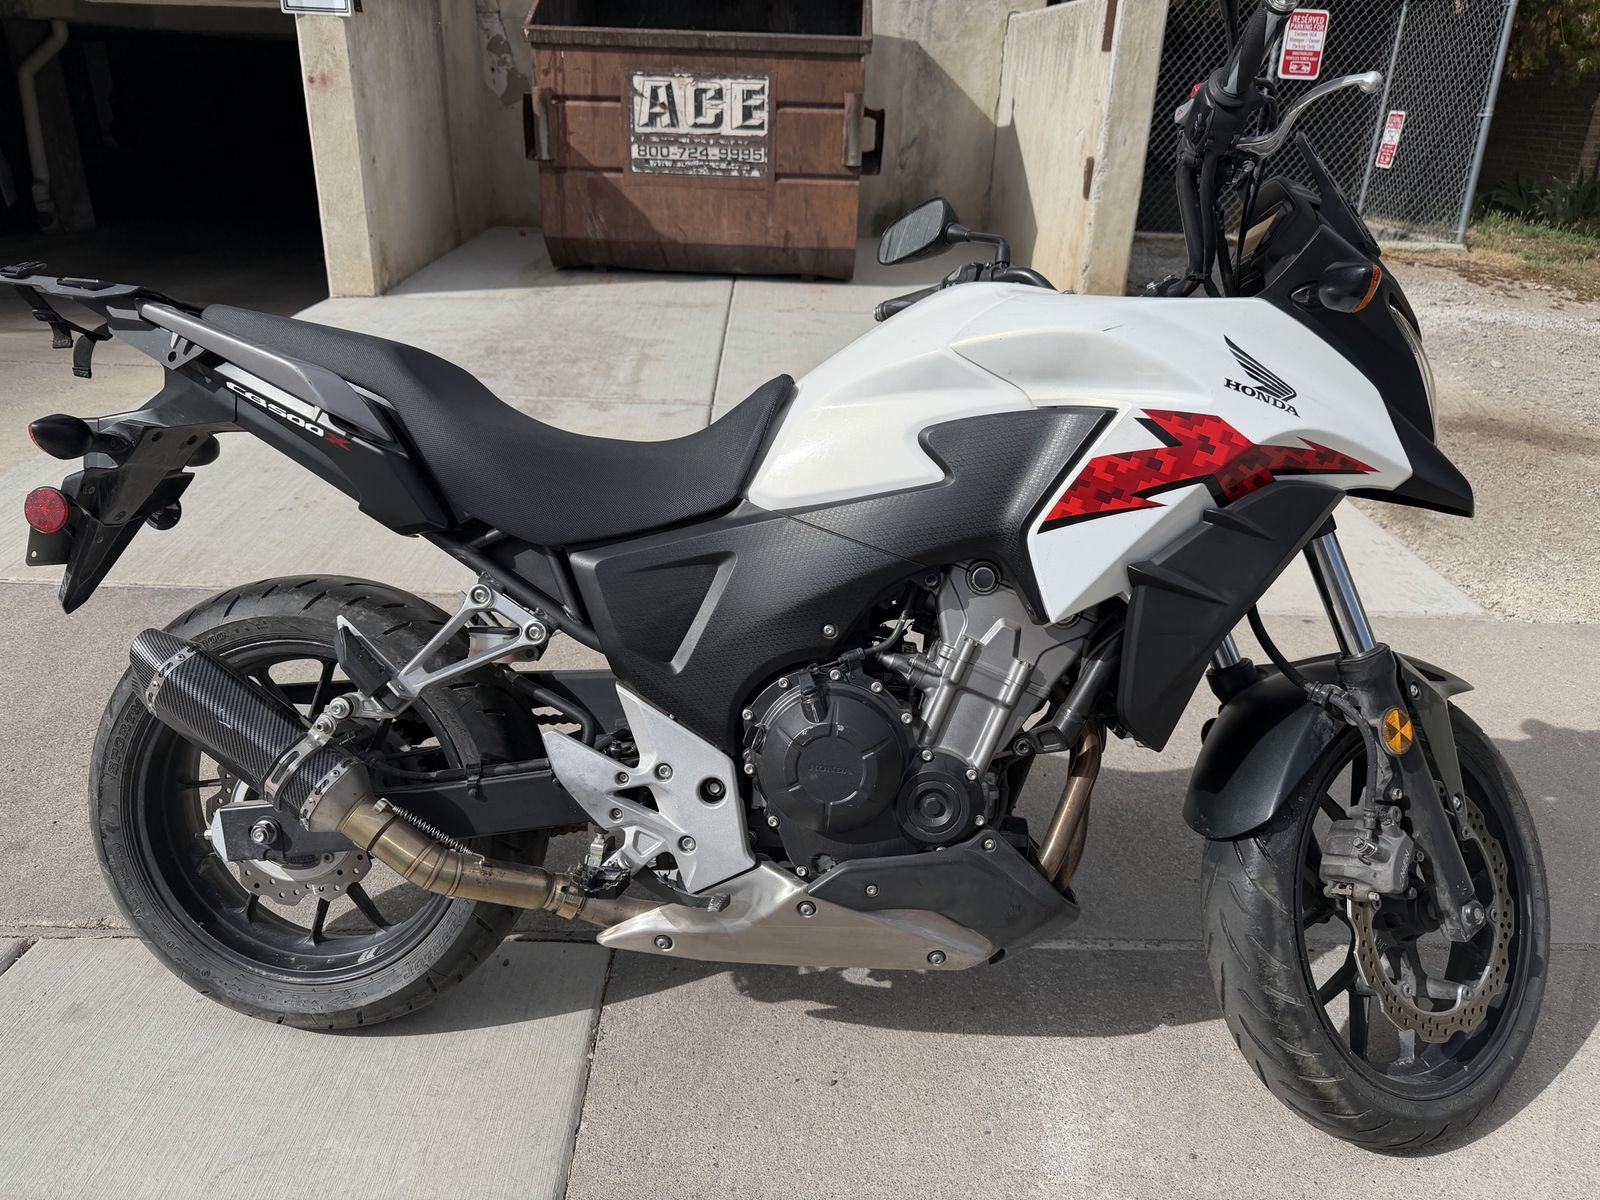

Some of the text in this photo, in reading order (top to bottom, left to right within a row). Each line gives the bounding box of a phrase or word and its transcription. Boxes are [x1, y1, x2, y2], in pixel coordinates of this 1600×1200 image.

[1290, 23, 1313, 31] PARKING
[1292, 15, 1325, 25] RESERVED
[637, 79, 766, 131] ACE
[637, 145, 763, 161] 800-724-9995
[1223, 377, 1301, 418] HONDA
[226, 381, 352, 452] CB500X
